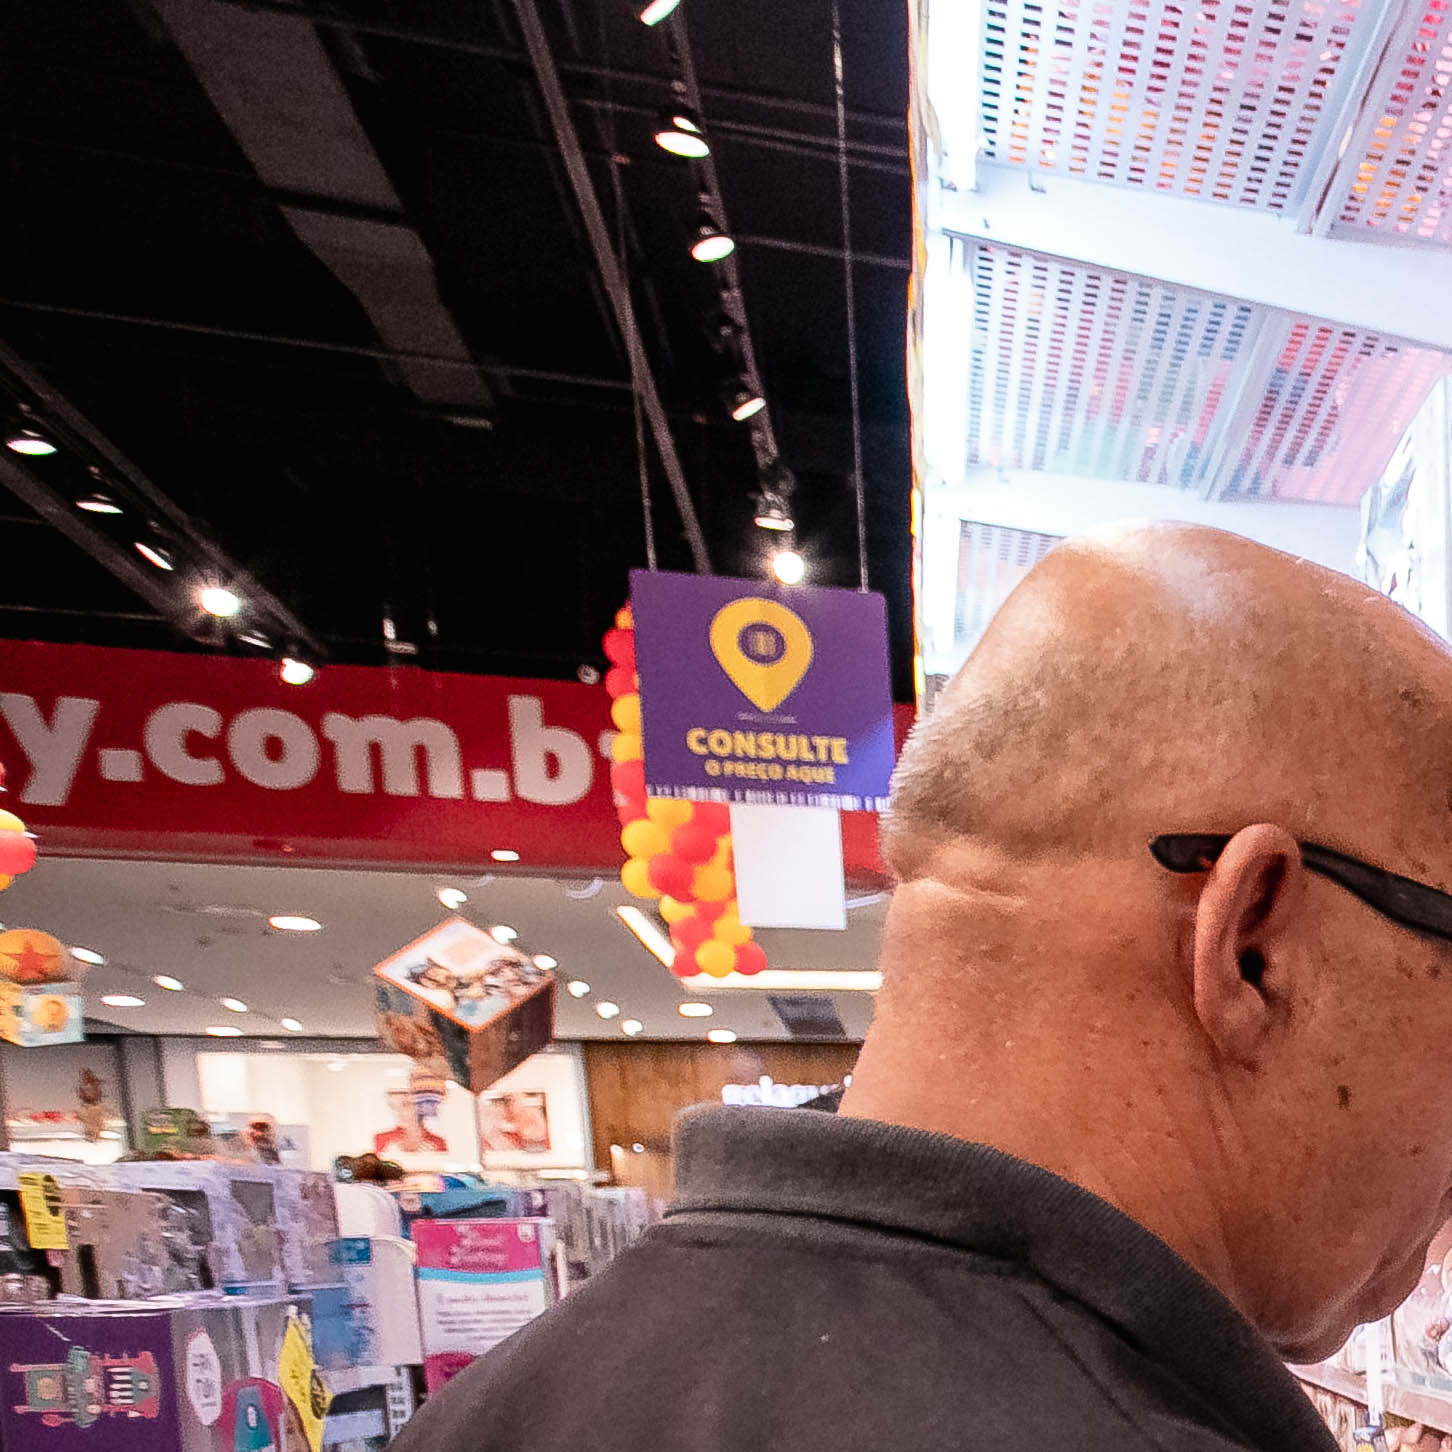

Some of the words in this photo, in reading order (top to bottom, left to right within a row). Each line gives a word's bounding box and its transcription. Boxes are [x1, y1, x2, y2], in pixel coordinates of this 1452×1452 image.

[0, 692, 613, 807] y.com.b
[686, 727, 849, 765] CONSULTE
[704, 759, 722, 777] O
